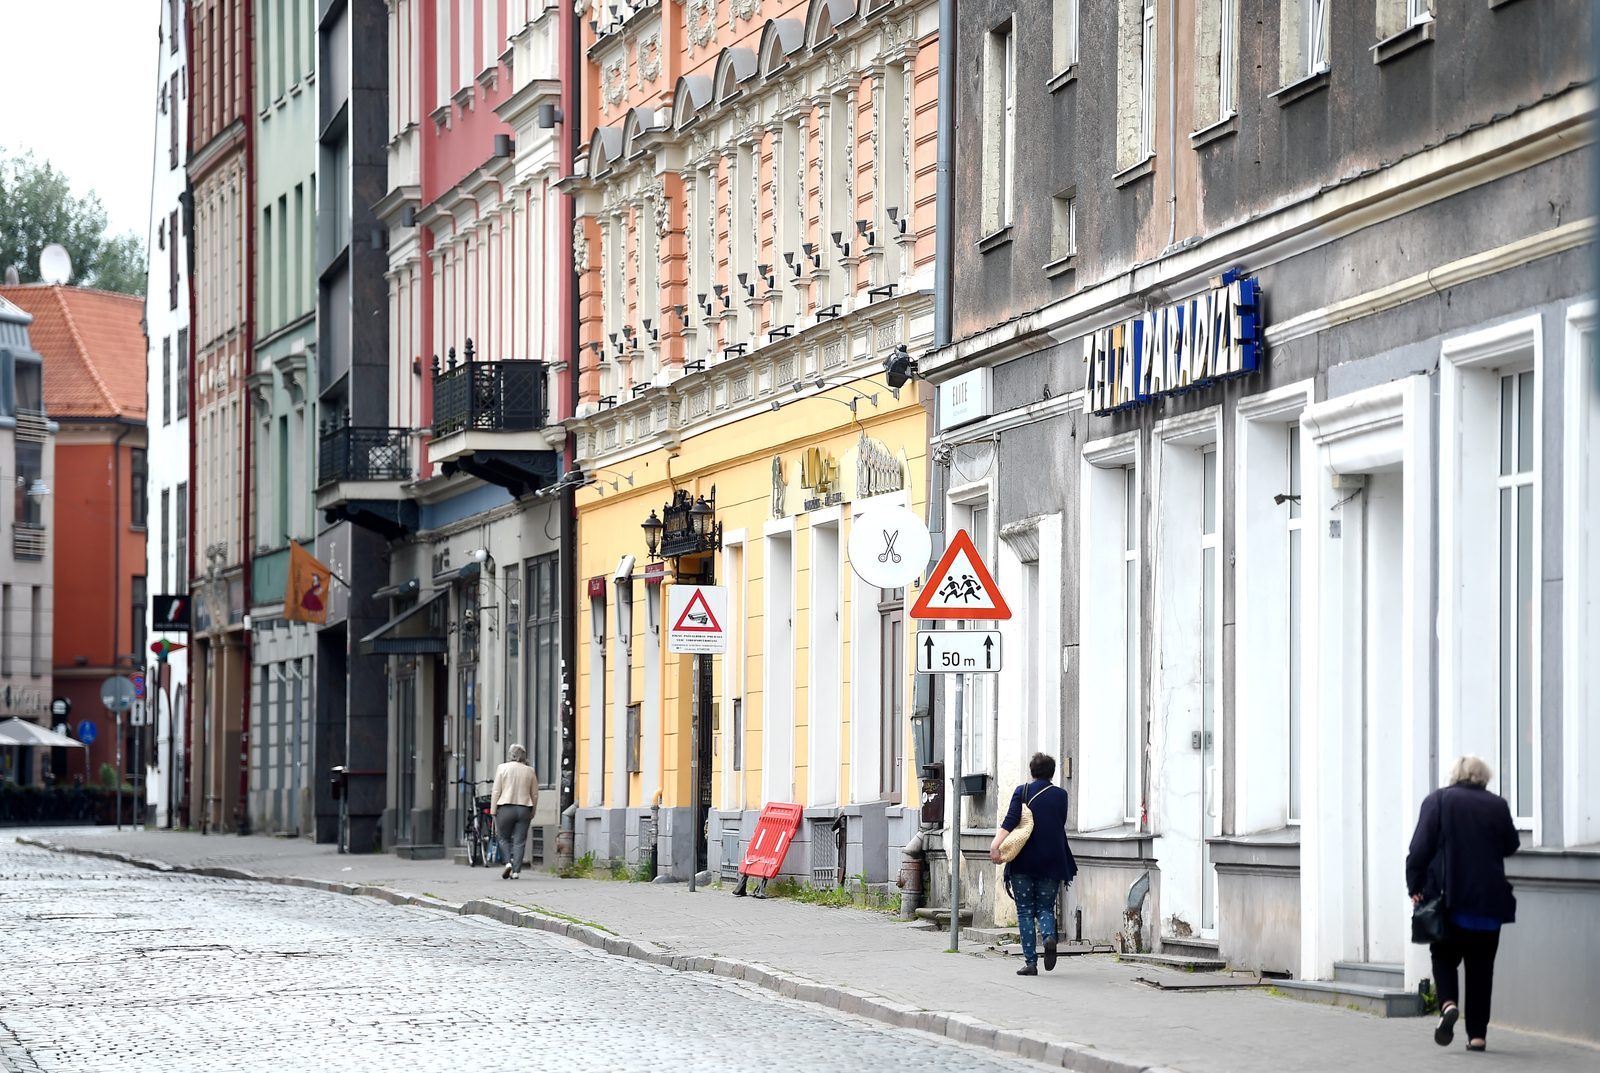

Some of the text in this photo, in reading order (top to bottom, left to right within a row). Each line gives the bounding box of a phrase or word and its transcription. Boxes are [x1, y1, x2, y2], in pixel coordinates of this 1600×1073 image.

[1082, 272, 1246, 414] ZELTA PARADĪZE
[952, 381, 968, 407] ELITE
[942, 651, 976, 667] 50 m
